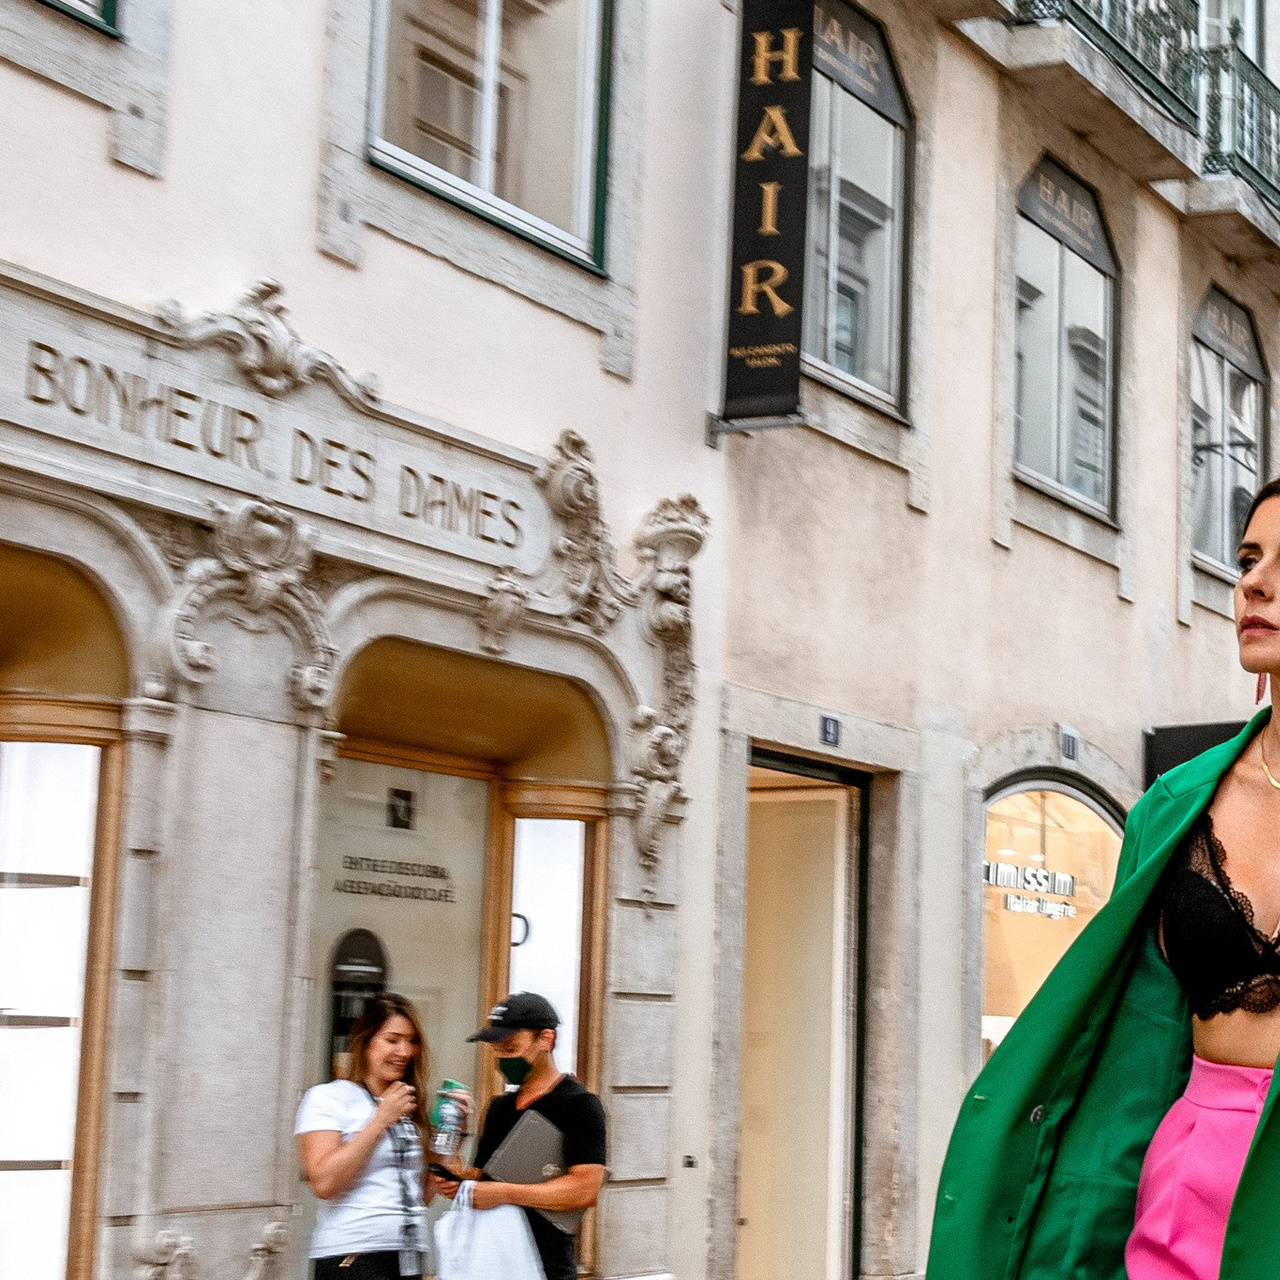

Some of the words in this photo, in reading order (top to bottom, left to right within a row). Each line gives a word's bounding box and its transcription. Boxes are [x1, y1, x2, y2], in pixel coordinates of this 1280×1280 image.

[737, 26, 804, 320] HAIR
[1039, 173, 1095, 240] HAIR
[24, 339, 264, 472] BONHEUR
[291, 426, 376, 503] DES
[400, 463, 525, 549] DAMES
